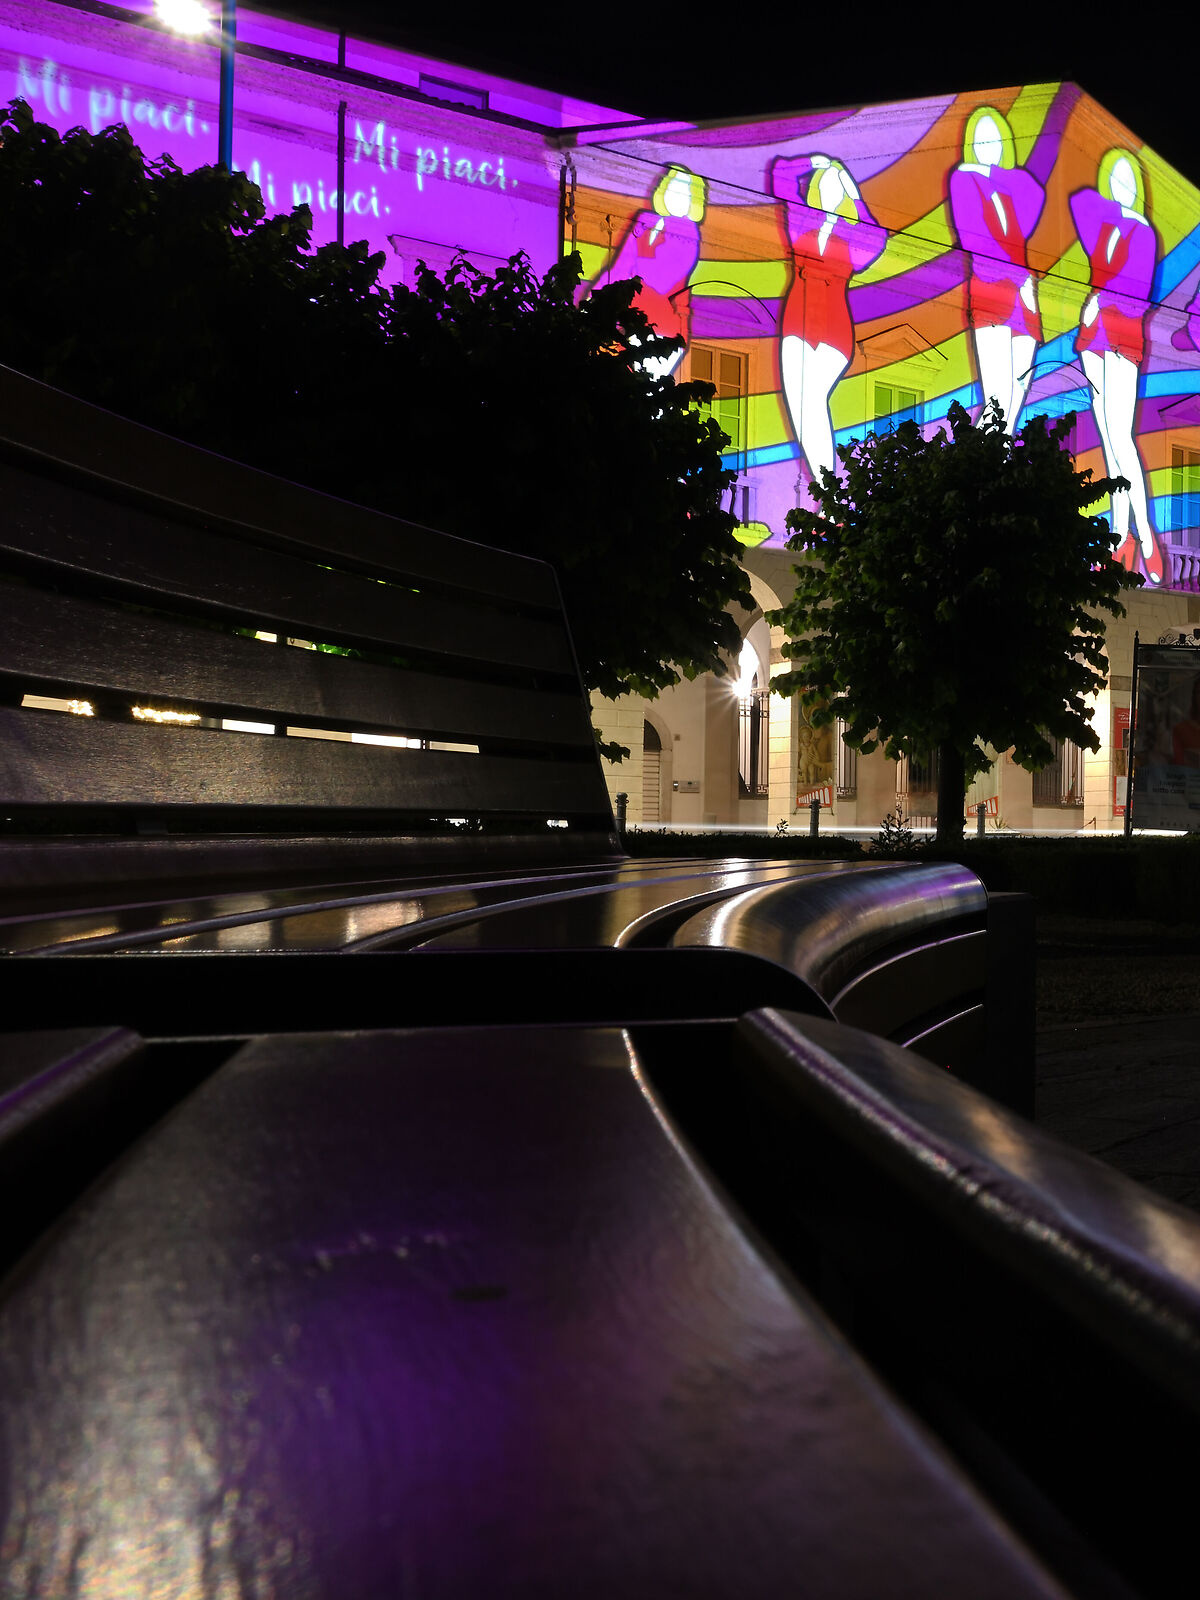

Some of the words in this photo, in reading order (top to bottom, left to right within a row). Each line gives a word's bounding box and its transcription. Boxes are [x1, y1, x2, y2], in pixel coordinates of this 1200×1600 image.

[16, 57, 71, 118] Mi
[89, 86, 210, 138] piaci.
[354, 121, 400, 173] Mi
[416, 147, 519, 191] piaci.
